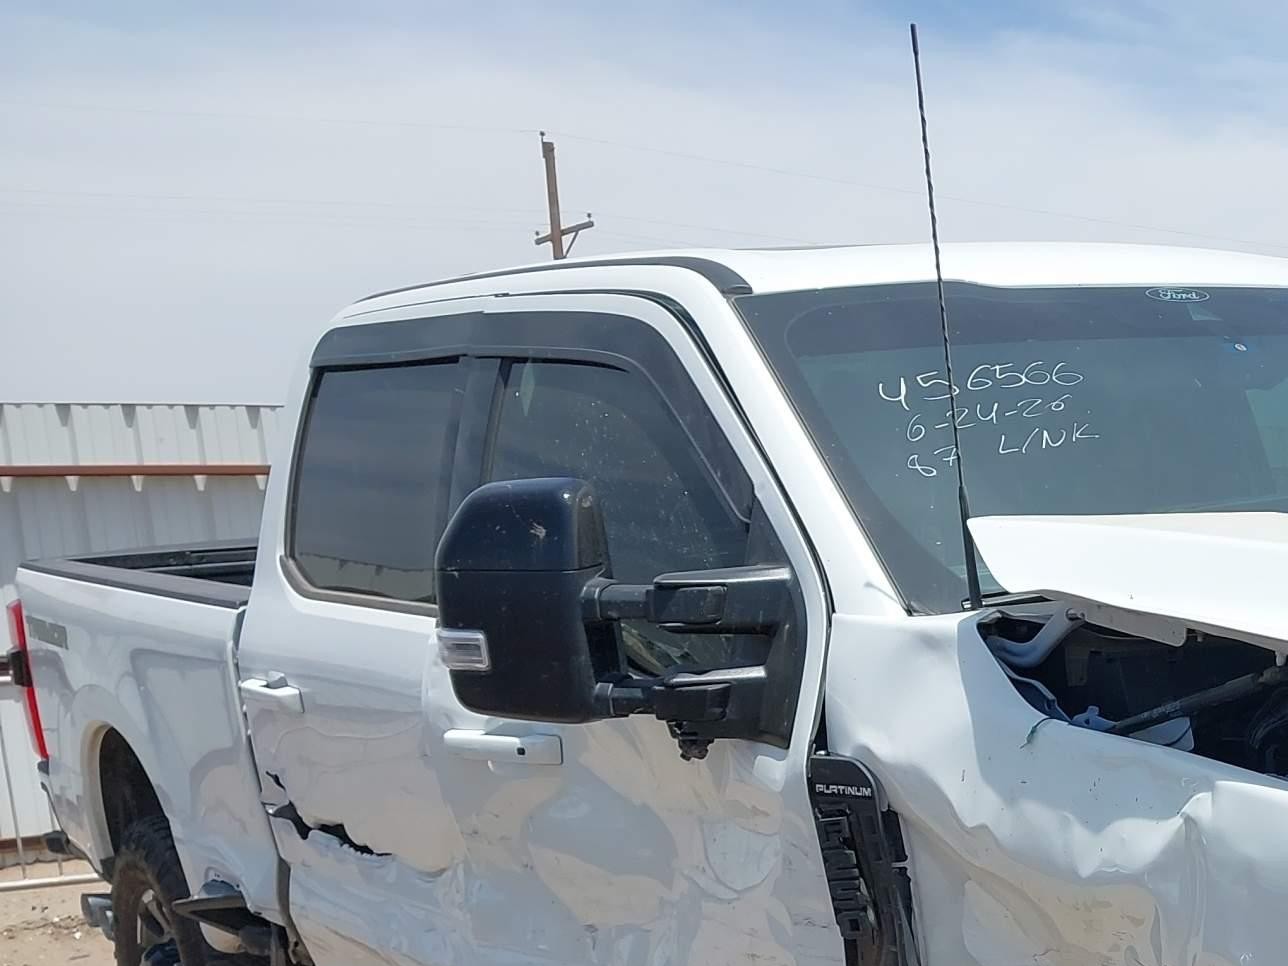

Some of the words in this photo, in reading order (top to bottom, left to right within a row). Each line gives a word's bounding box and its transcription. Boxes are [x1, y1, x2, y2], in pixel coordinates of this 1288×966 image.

[1158, 288, 1201, 301] Ford
[878, 361, 1084, 411] 456566
[907, 445, 959, 477] 87
[815, 783, 872, 797] PLATINUM
